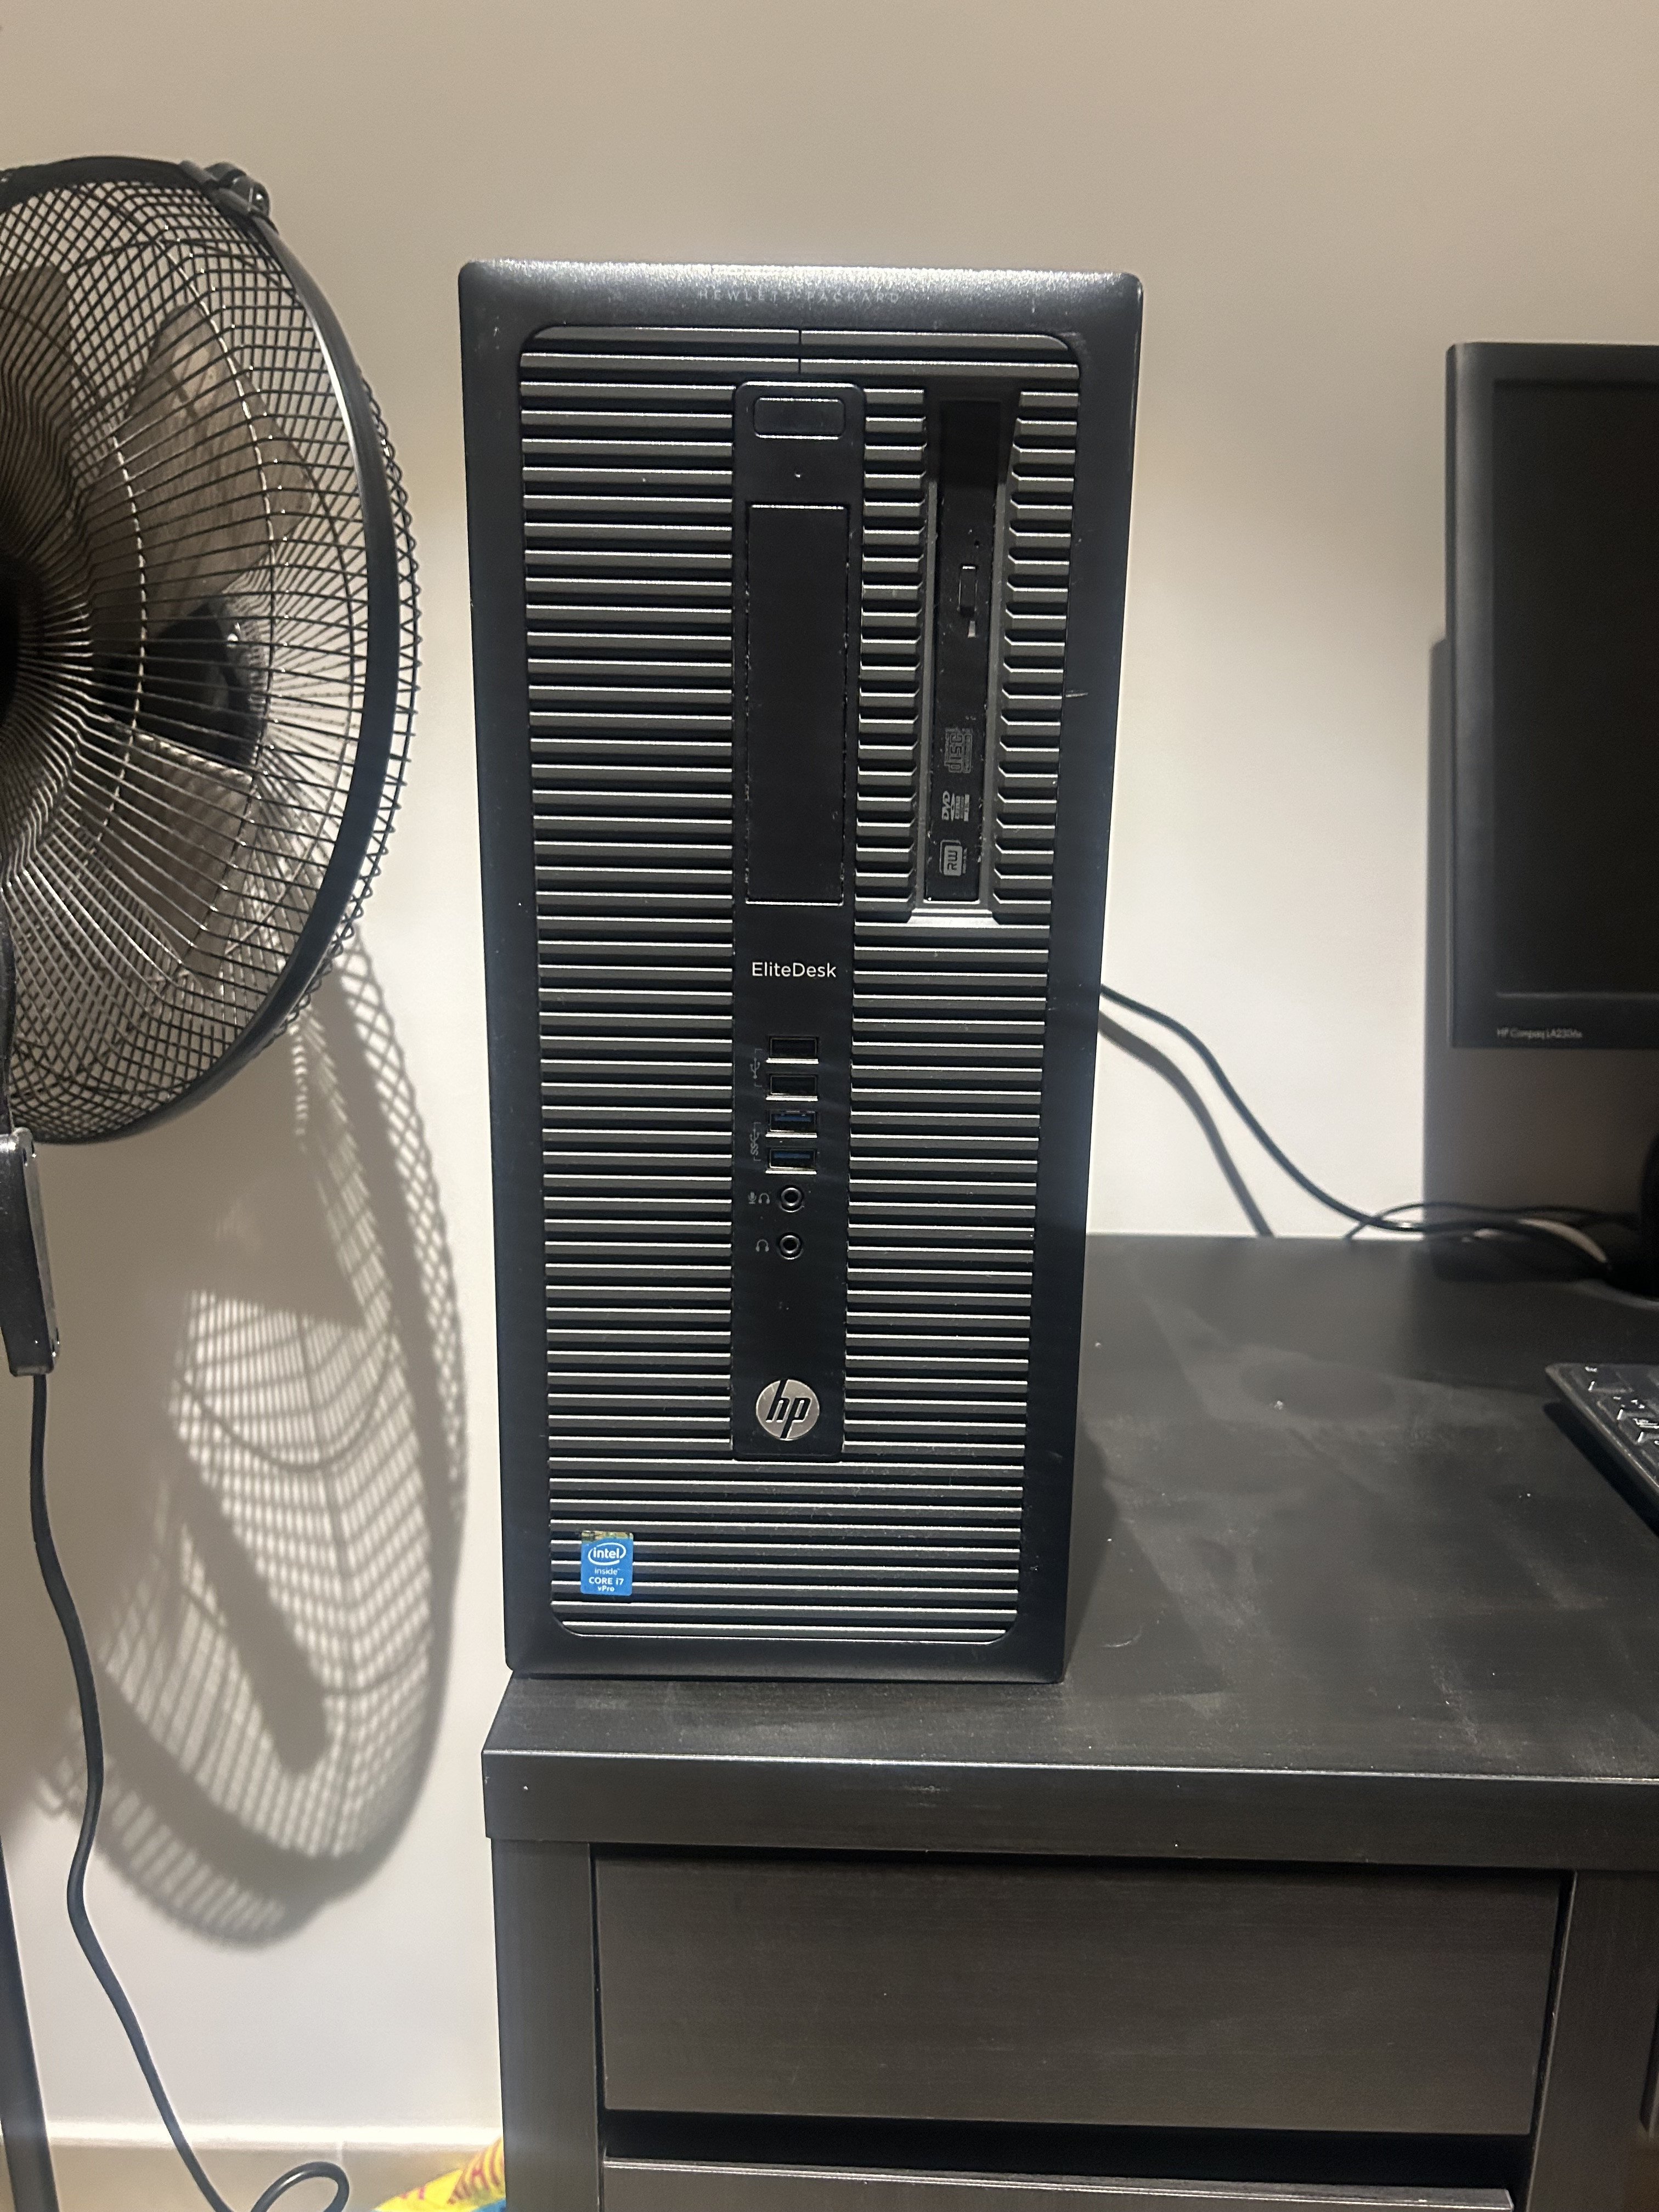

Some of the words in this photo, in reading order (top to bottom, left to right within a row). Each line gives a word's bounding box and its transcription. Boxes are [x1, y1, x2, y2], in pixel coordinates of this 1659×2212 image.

[941, 791, 950, 821] DVD
[947, 850, 958, 871] RW
[752, 961, 837, 978] EliteDesk
[766, 1379, 812, 1439] hp
[593, 1547, 619, 1559] intel
[588, 1577, 613, 1585] CORE
